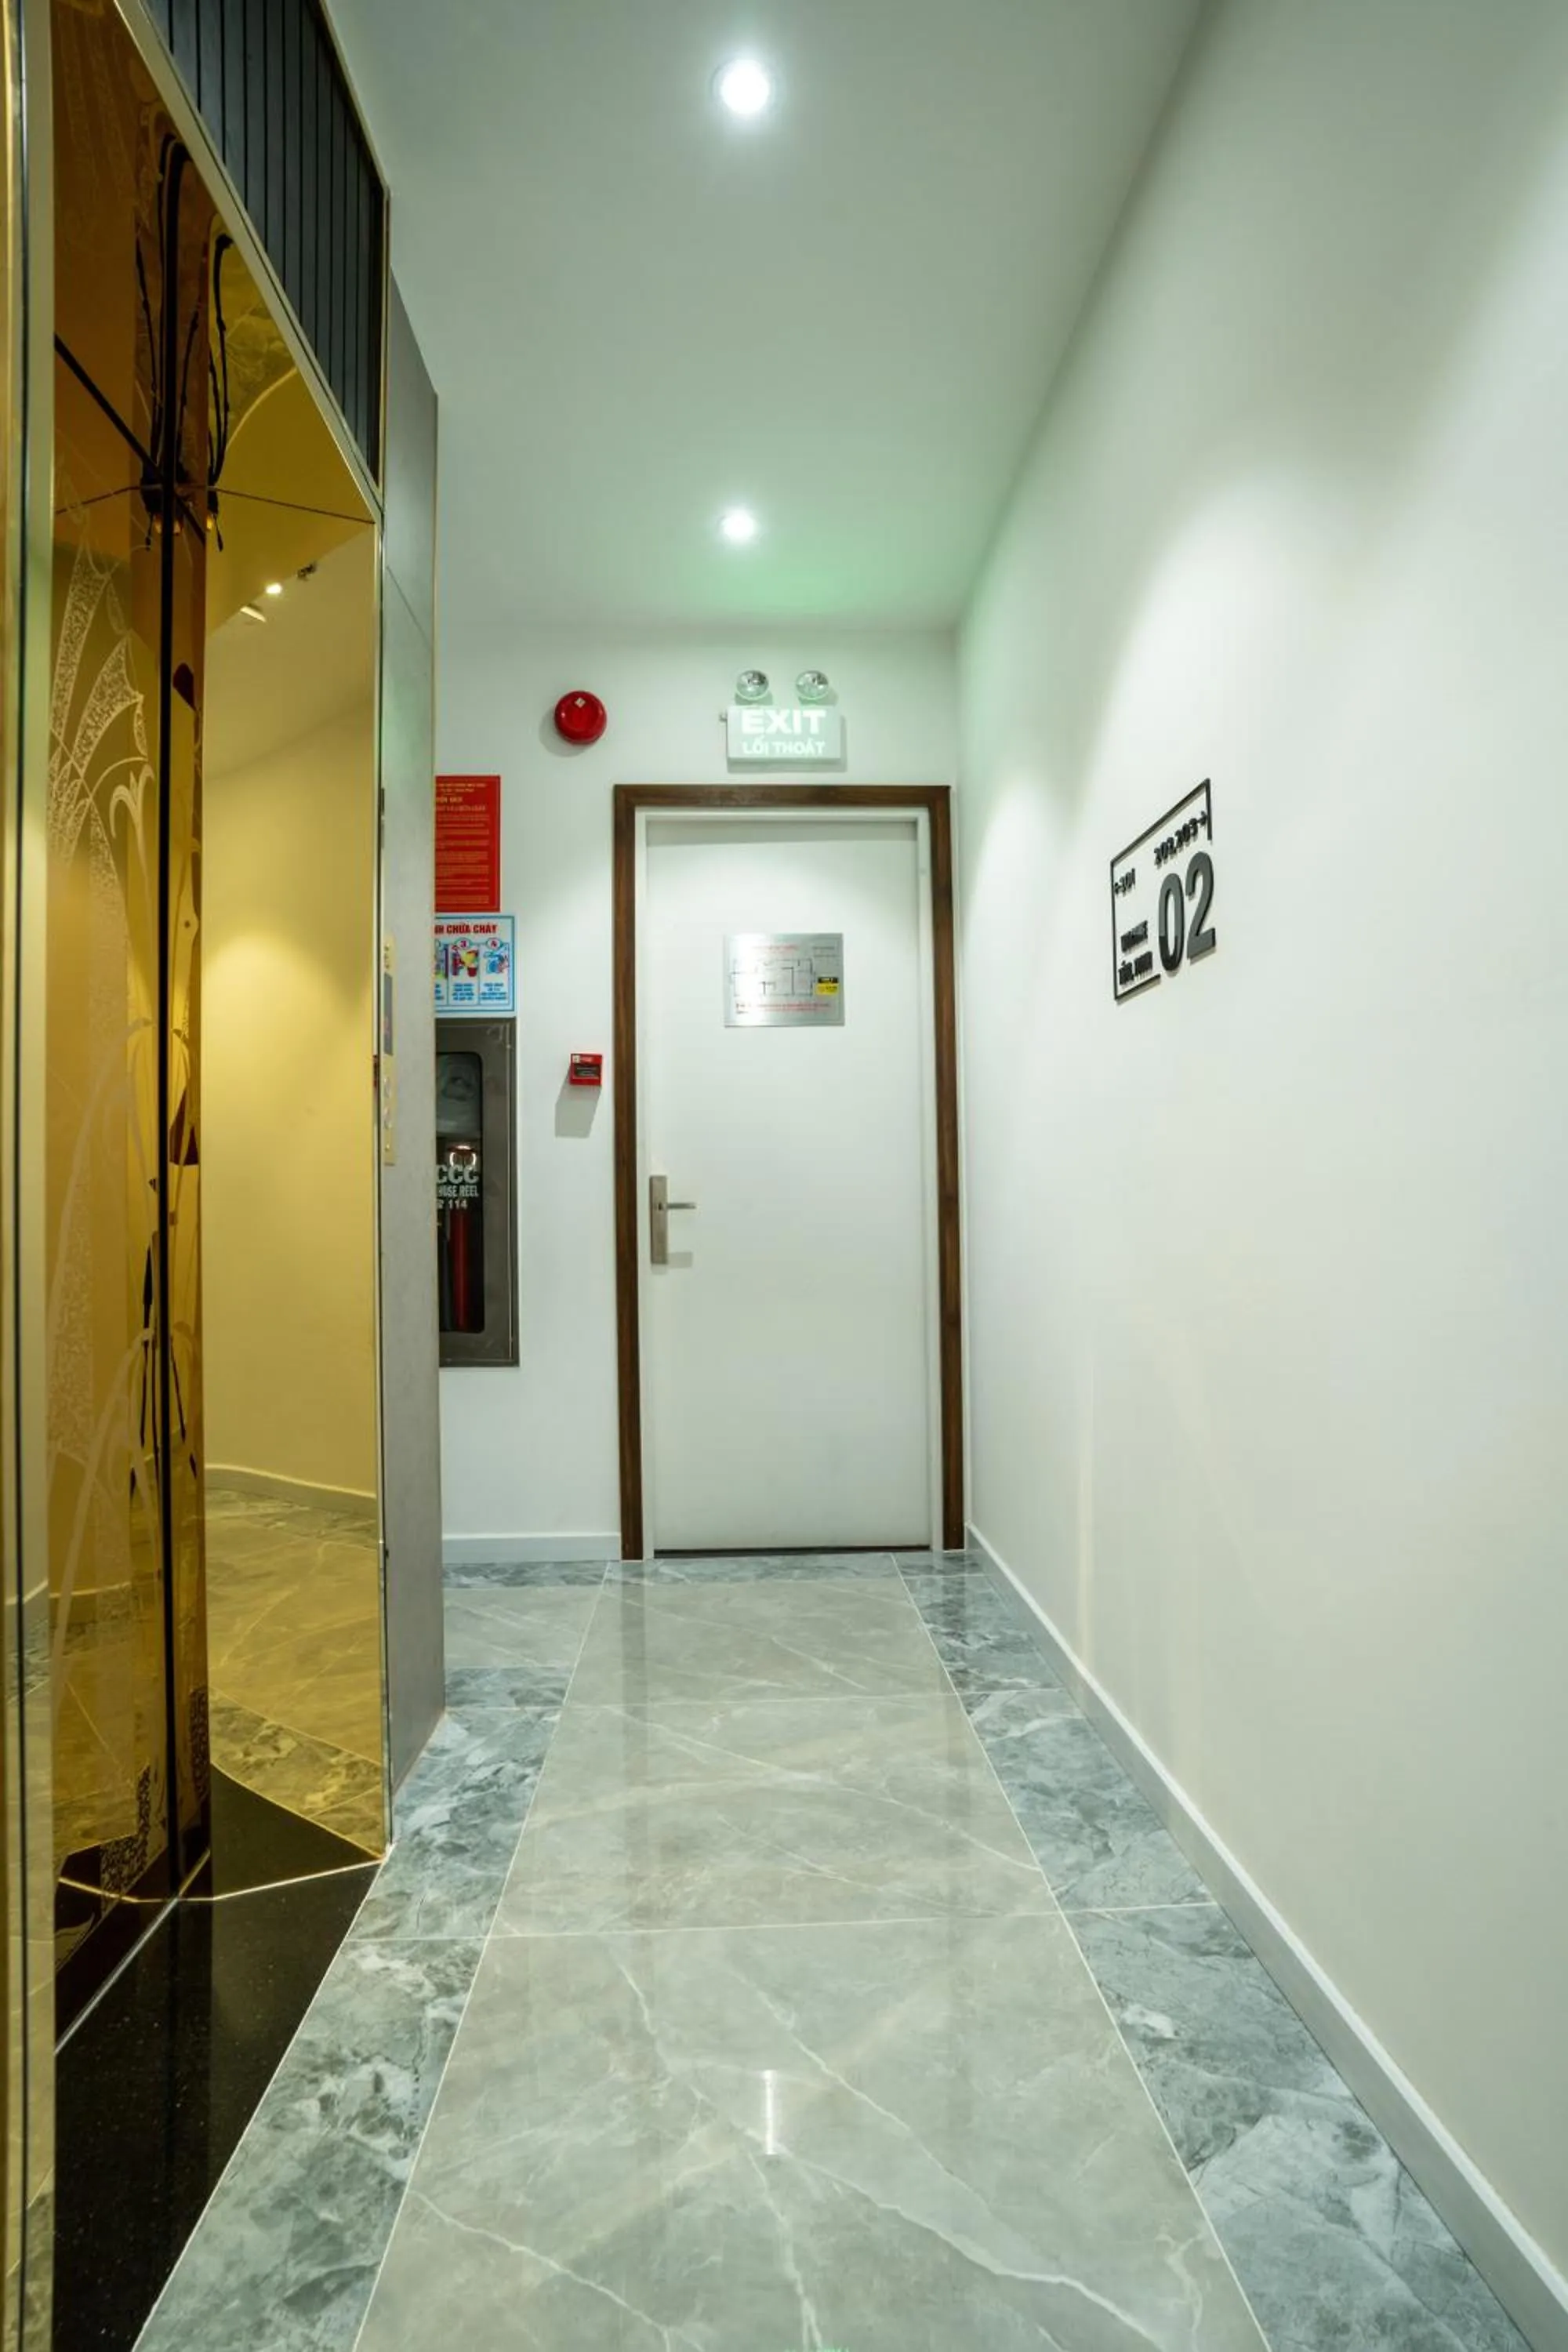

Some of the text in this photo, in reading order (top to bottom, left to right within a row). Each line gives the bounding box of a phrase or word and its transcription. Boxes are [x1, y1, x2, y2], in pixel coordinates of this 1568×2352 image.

[742, 709, 826, 734] EXIT
[742, 735, 826, 756] LỐI THOÁT
[1159, 851, 1216, 971] 02
[459, 1185, 479, 1197] REEL
[448, 1200, 468, 1209] 114
